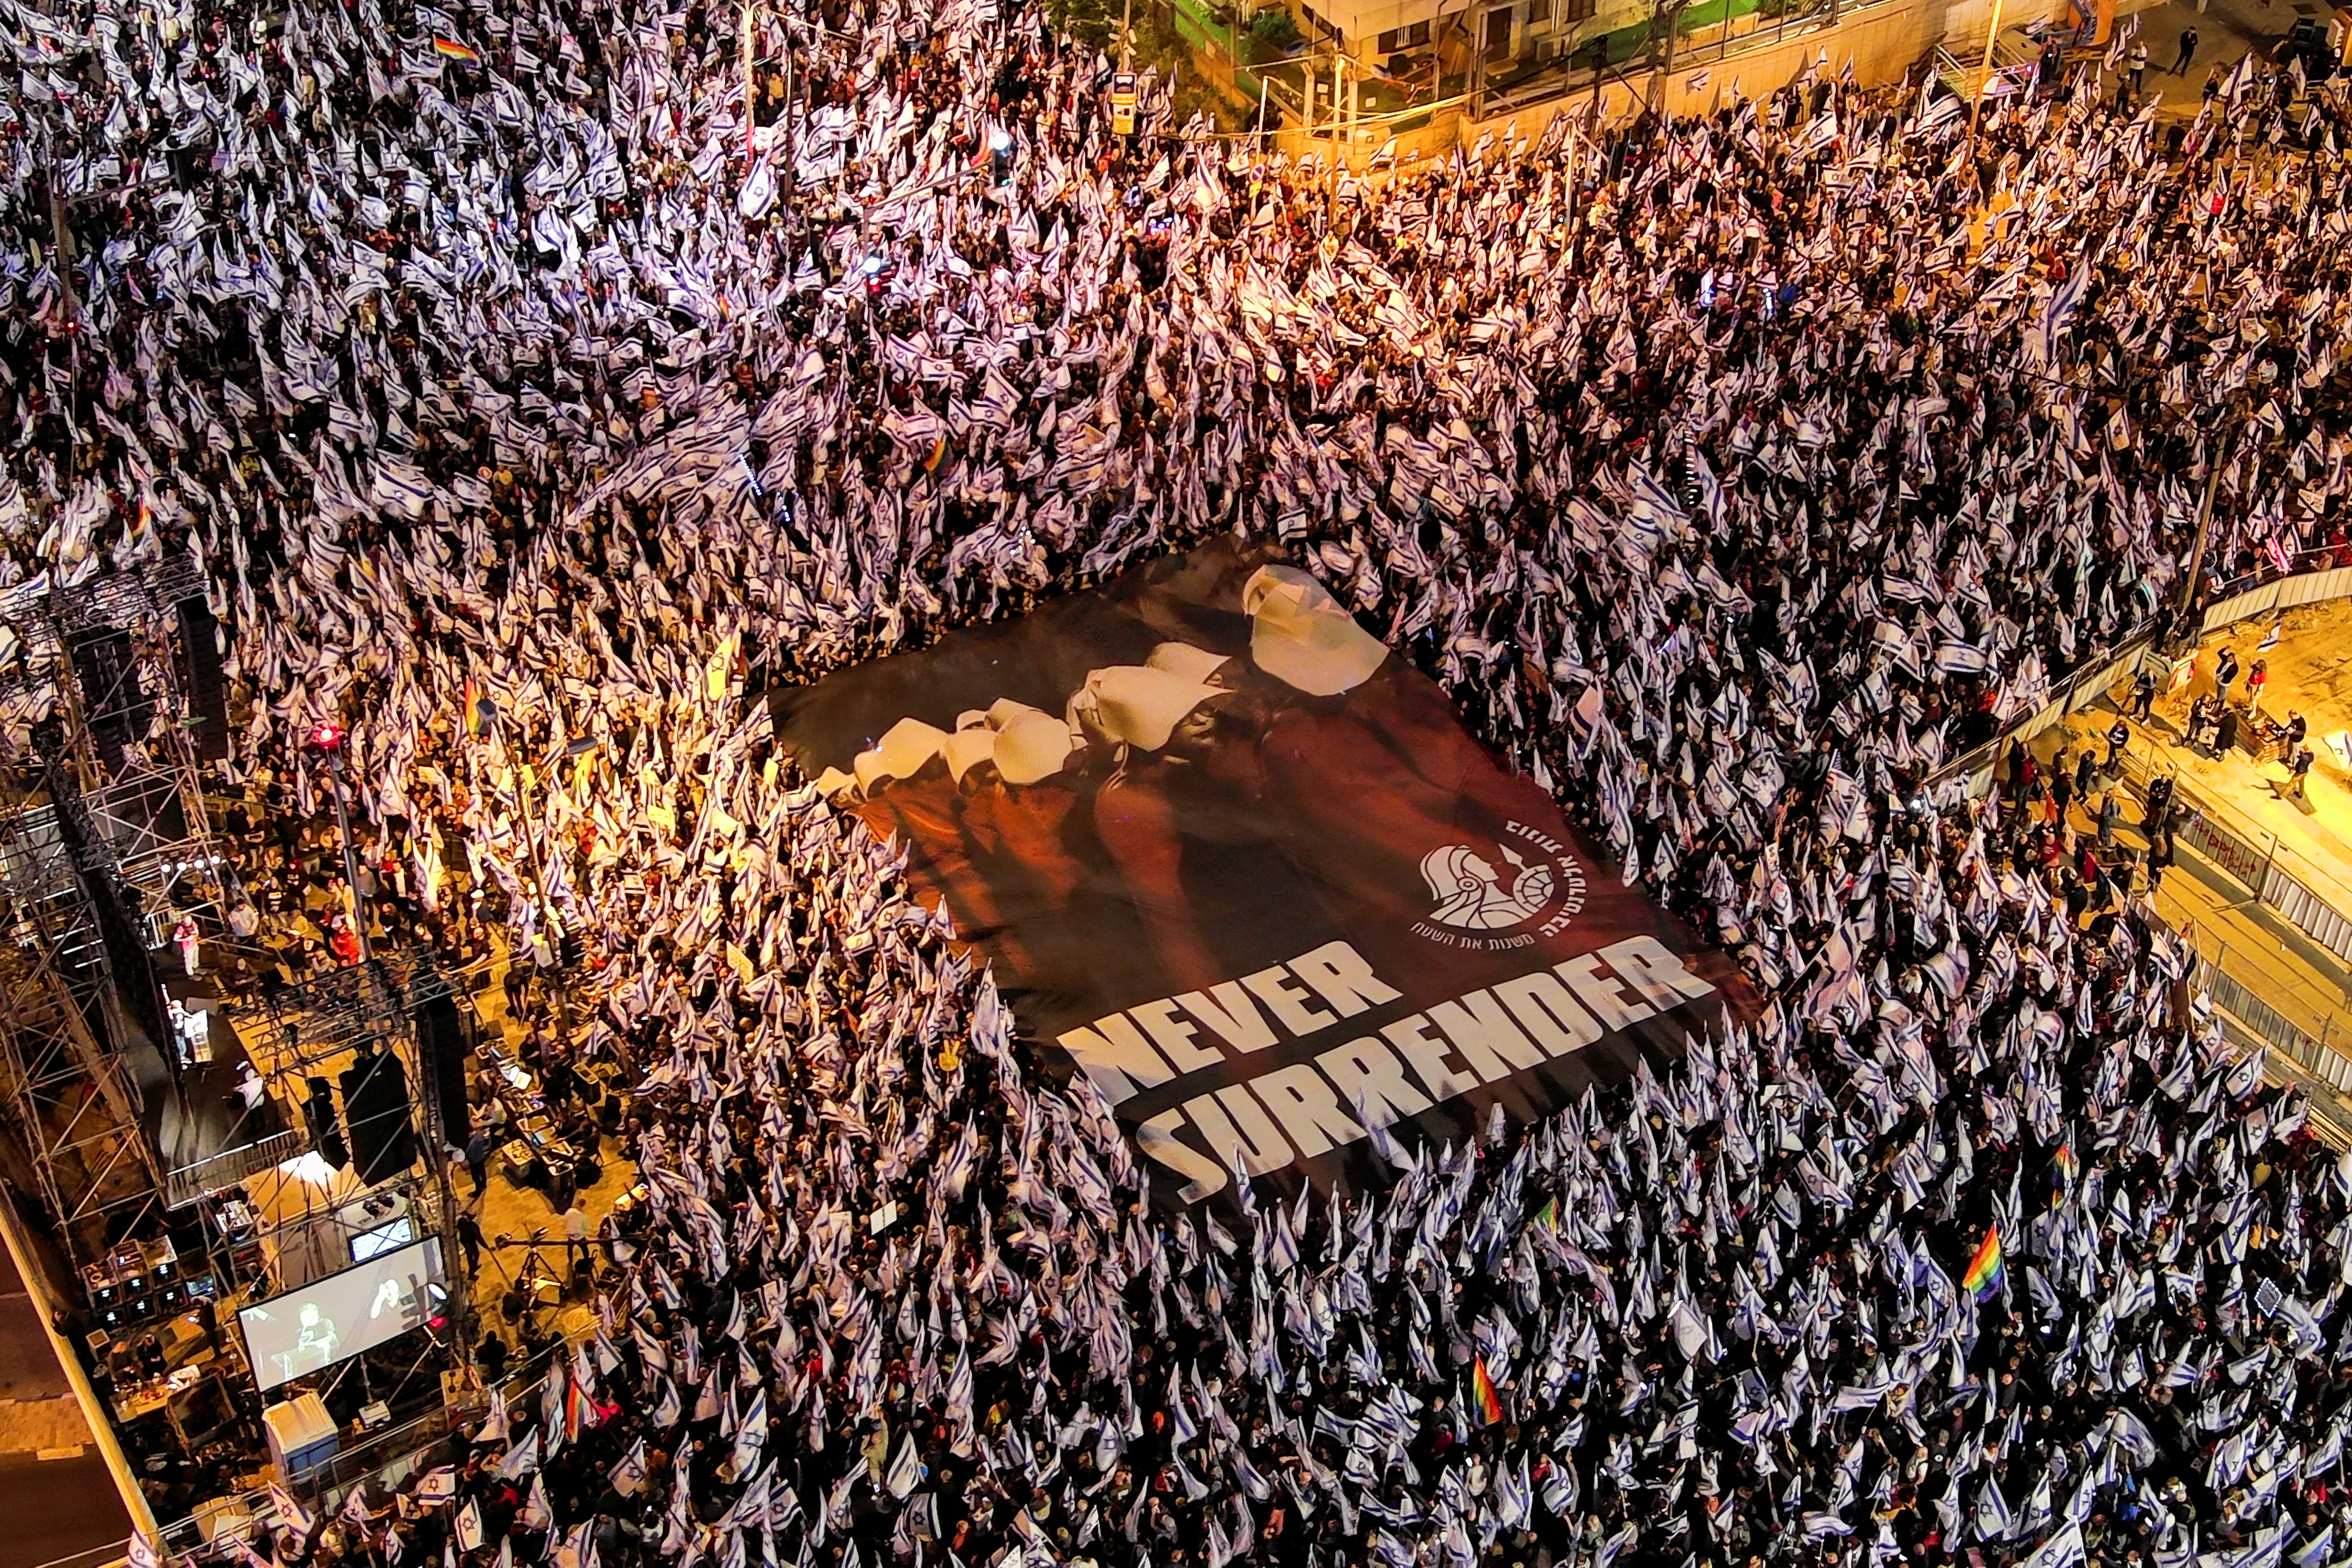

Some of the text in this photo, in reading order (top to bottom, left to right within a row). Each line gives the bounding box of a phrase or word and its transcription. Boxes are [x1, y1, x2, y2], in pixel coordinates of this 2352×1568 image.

[1410, 921, 1535, 950] משנות את השטח
[1505, 820, 1587, 937] בונות אלטרנטיבה
[1056, 940, 1404, 1106] NEVER
[1136, 934, 1717, 1205] SURRENDER
